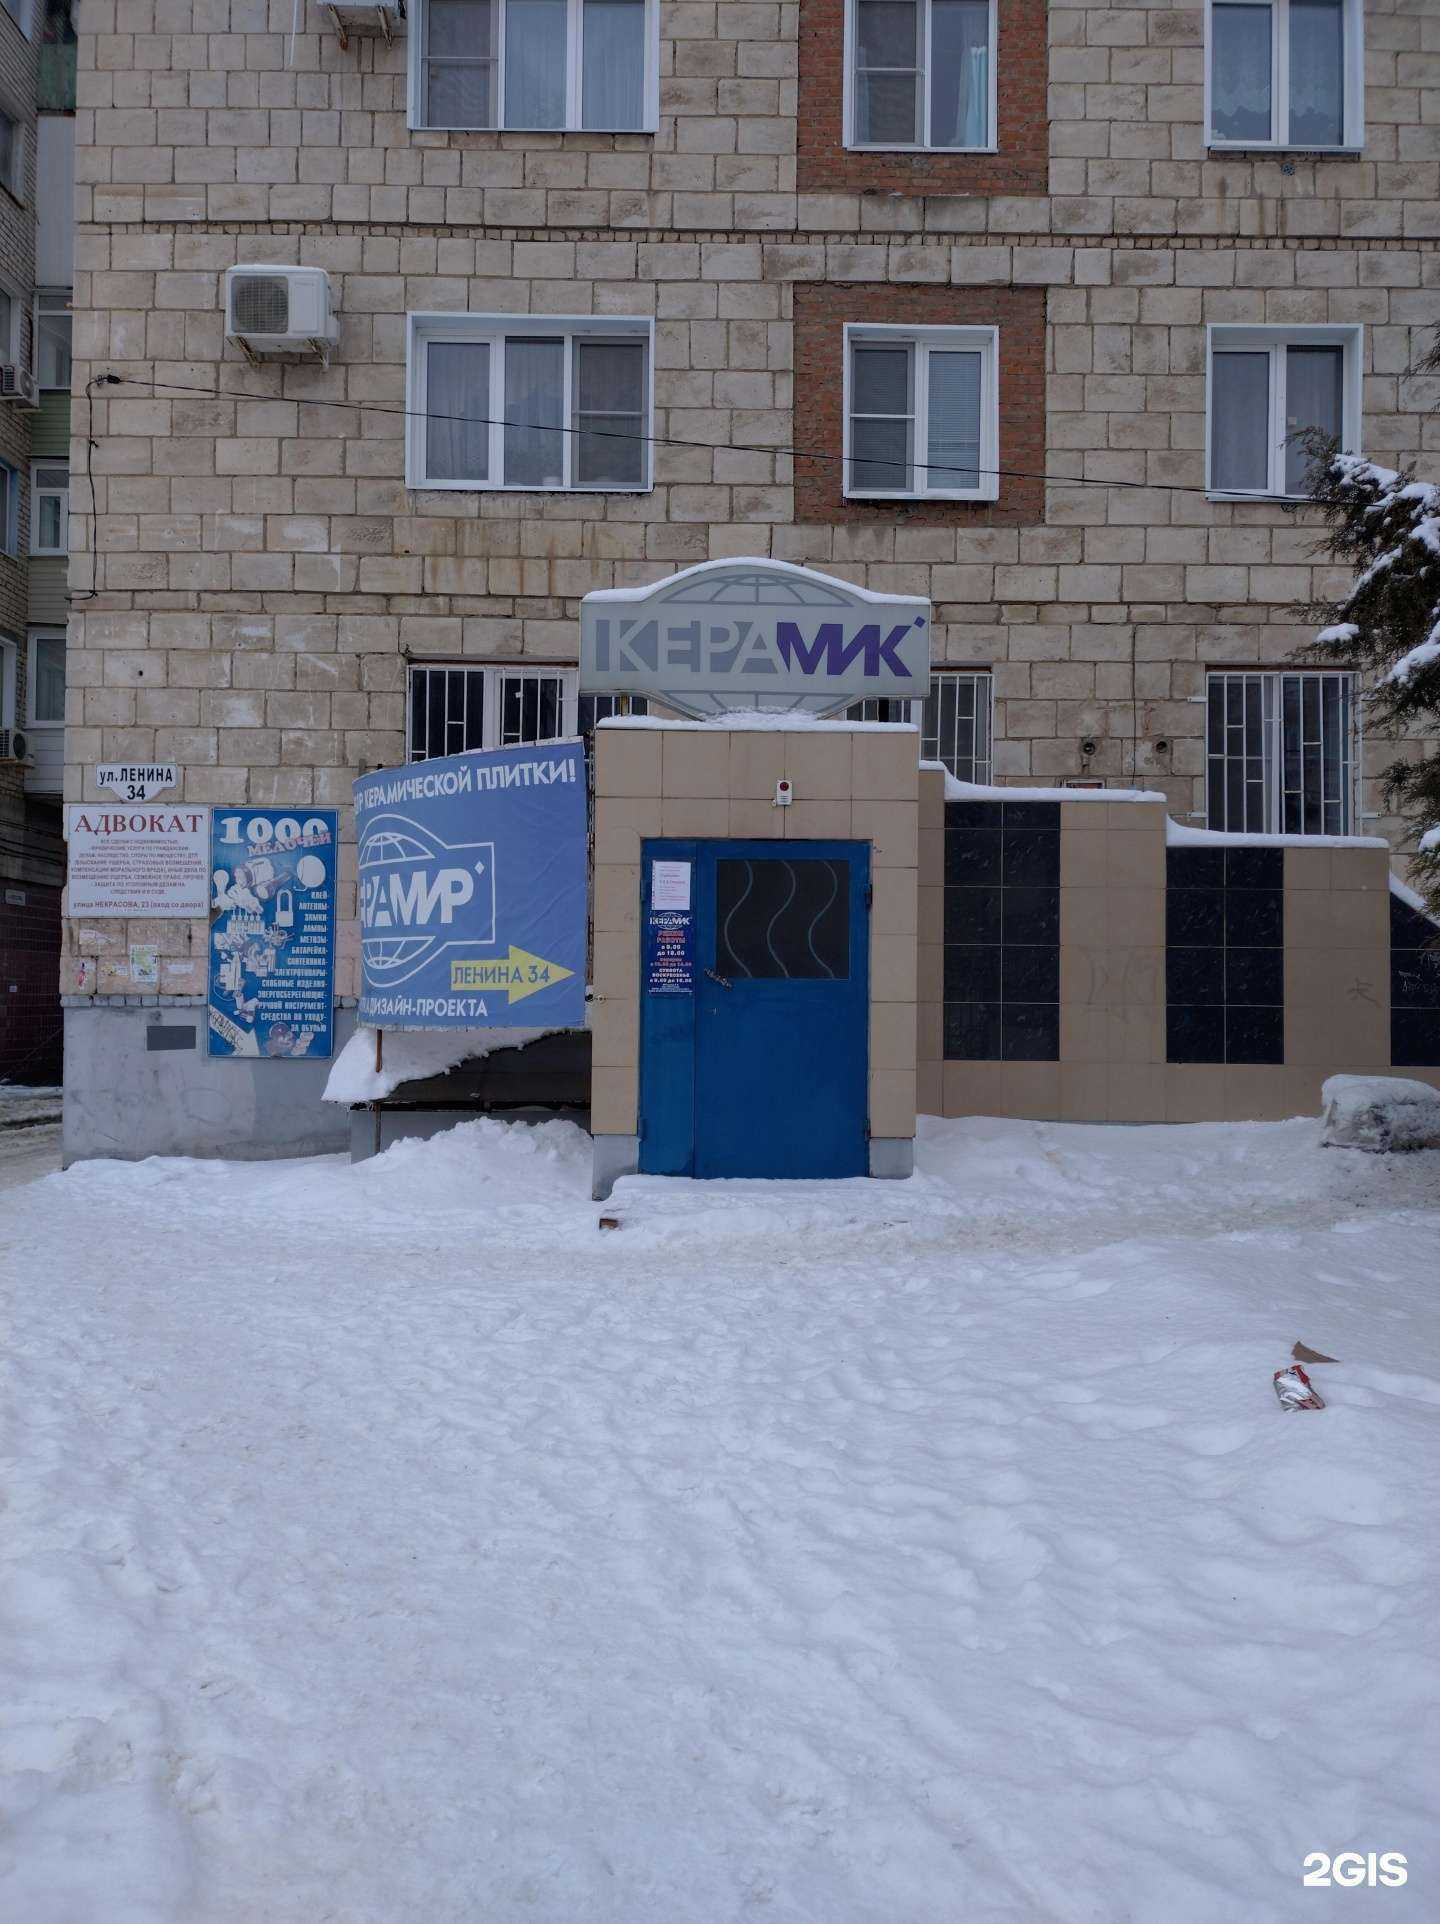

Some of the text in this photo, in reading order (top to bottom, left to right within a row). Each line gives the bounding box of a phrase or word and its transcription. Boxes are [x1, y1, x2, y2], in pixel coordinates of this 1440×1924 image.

[595, 619, 912, 677] КЕРАМИК
[127, 785, 146, 800] 34
[364, 766, 471, 809] КЕРАМИЧЕСКОЙ
[476, 758, 577, 791] ПЛИТКИ!
[74, 814, 203, 836] АДВОКАТ
[220, 817, 329, 844] 1000
[452, 965, 551, 985] ЛЕНИНА 34
[369, 995, 488, 1017] ДИЗАЙН-ПРОЕКТА
